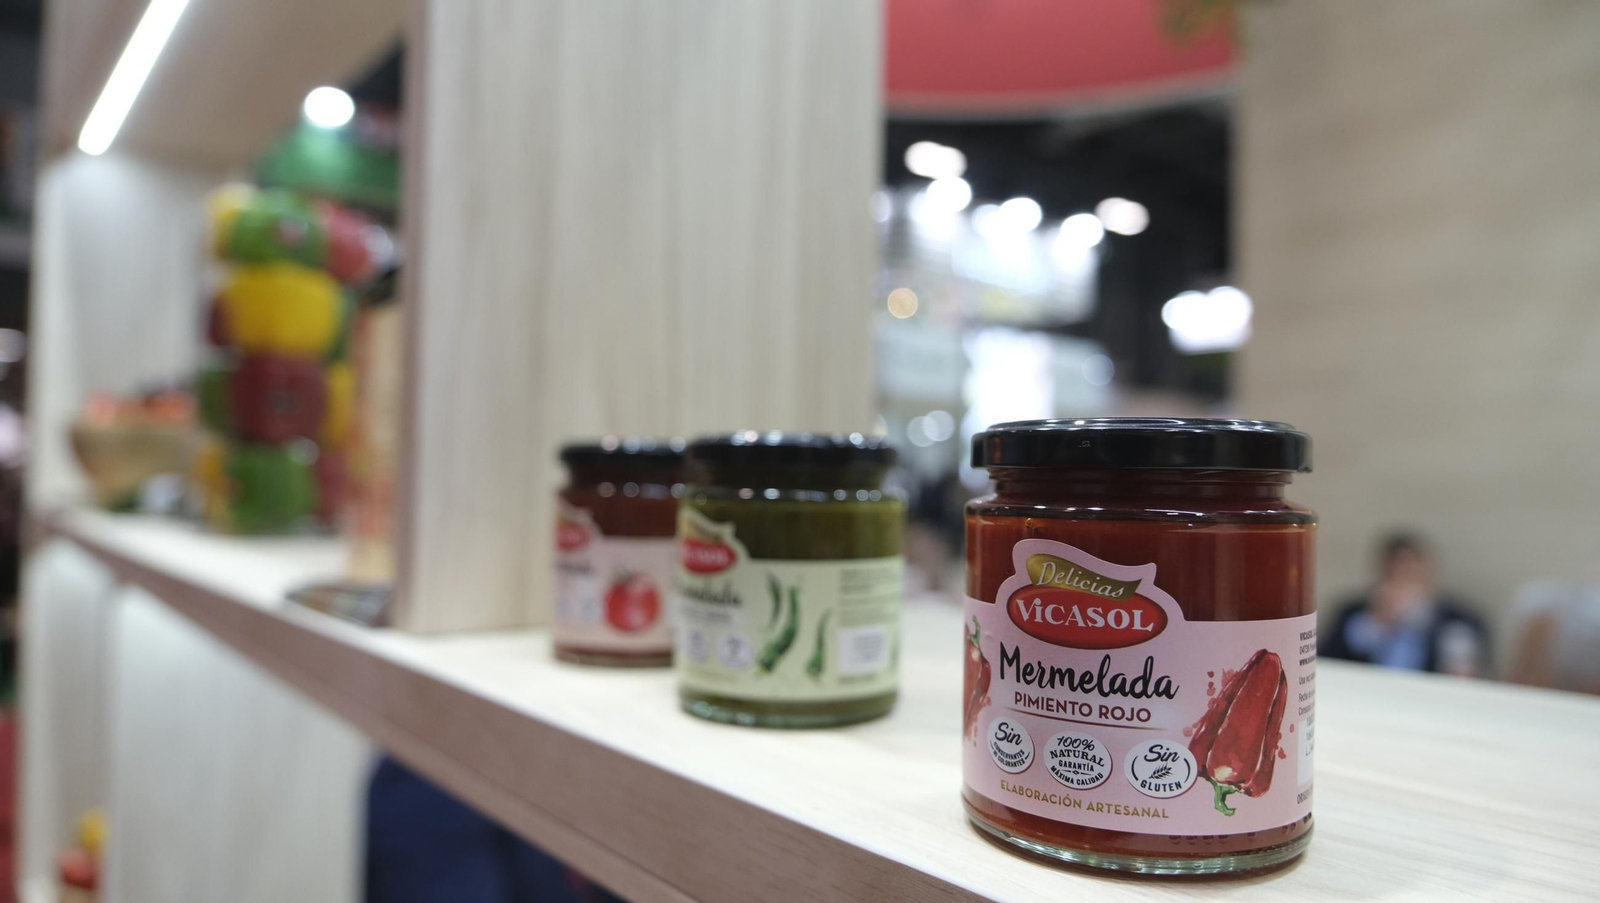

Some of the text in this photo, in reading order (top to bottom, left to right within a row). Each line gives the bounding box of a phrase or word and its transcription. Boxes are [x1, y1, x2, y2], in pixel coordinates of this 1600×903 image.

[1037, 561, 1125, 598] Delicias
[999, 641, 1180, 699] Mermelada
[1014, 693, 1152, 723] PIMIENTO ROJO
[994, 721, 1023, 746] Sin
[993, 741, 1025, 760] CONSERVANTES
[1056, 735, 1095, 752] 100%
[997, 755, 1026, 768] COLORANTES
[1049, 748, 1105, 767] NATURAL
[1143, 744, 1180, 763] Sin
[1058, 759, 1095, 772] GARANTÍA
[1050, 765, 1104, 786] MÁXIMA CALIDAD
[1139, 778, 1183, 793] GLUTEN
[1000, 779, 1169, 820] ELABORACIÓN ARTESANAL
